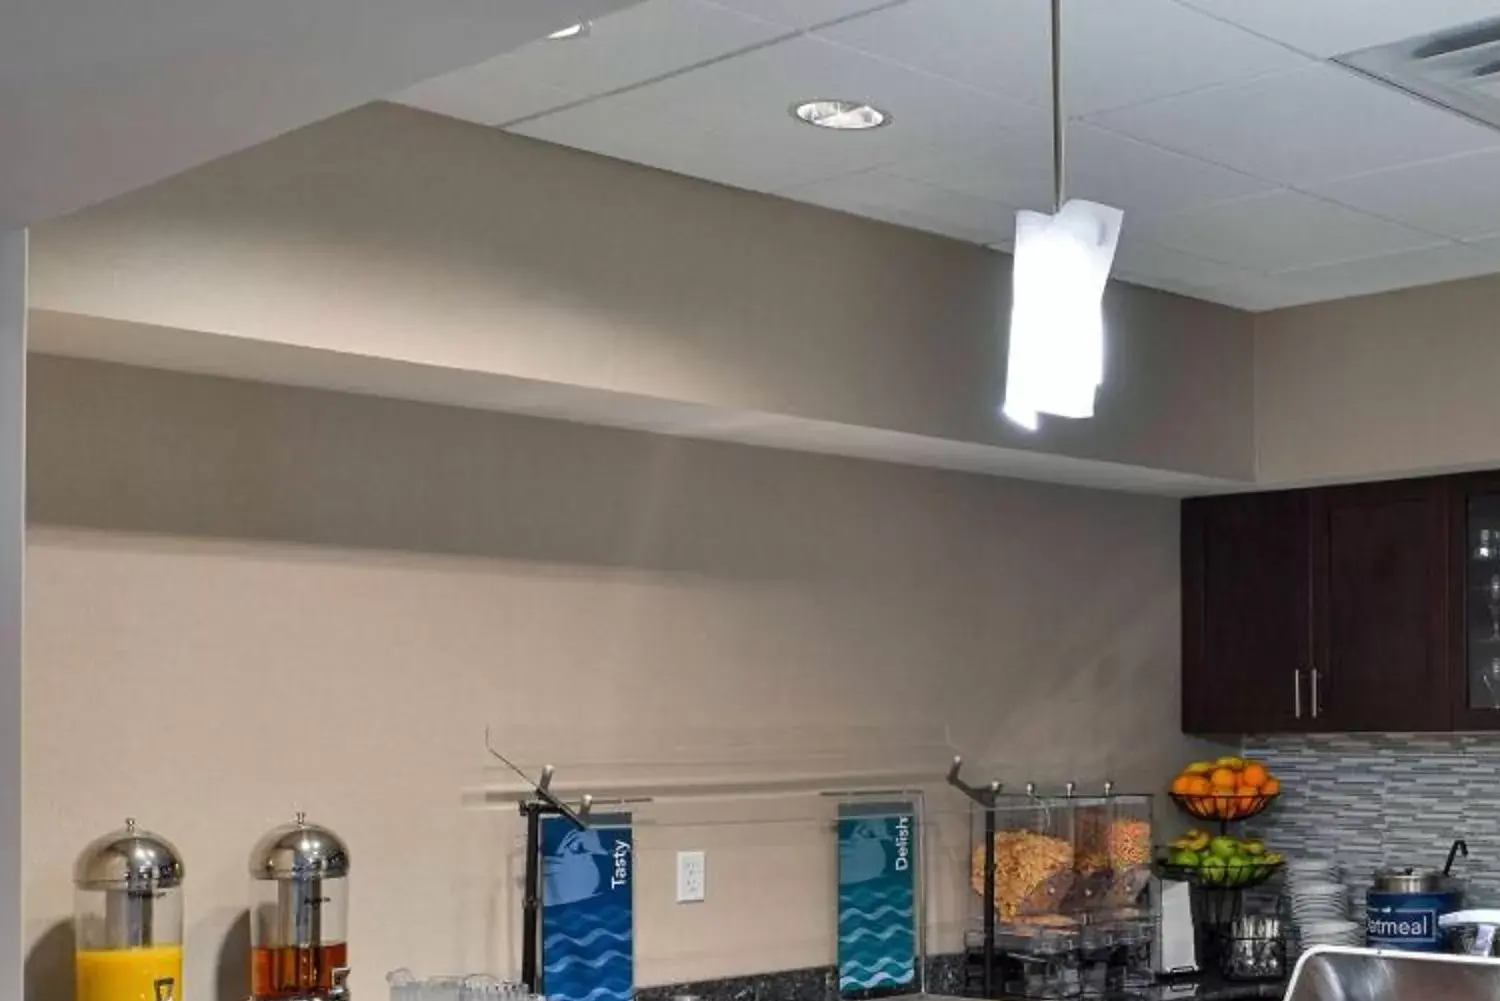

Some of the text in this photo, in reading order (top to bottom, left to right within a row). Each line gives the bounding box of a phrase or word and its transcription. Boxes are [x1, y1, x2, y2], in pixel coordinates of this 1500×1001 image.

[611, 839, 631, 890] Tasty
[895, 817, 909, 871] Delish
[1367, 915, 1428, 935] atmeal
